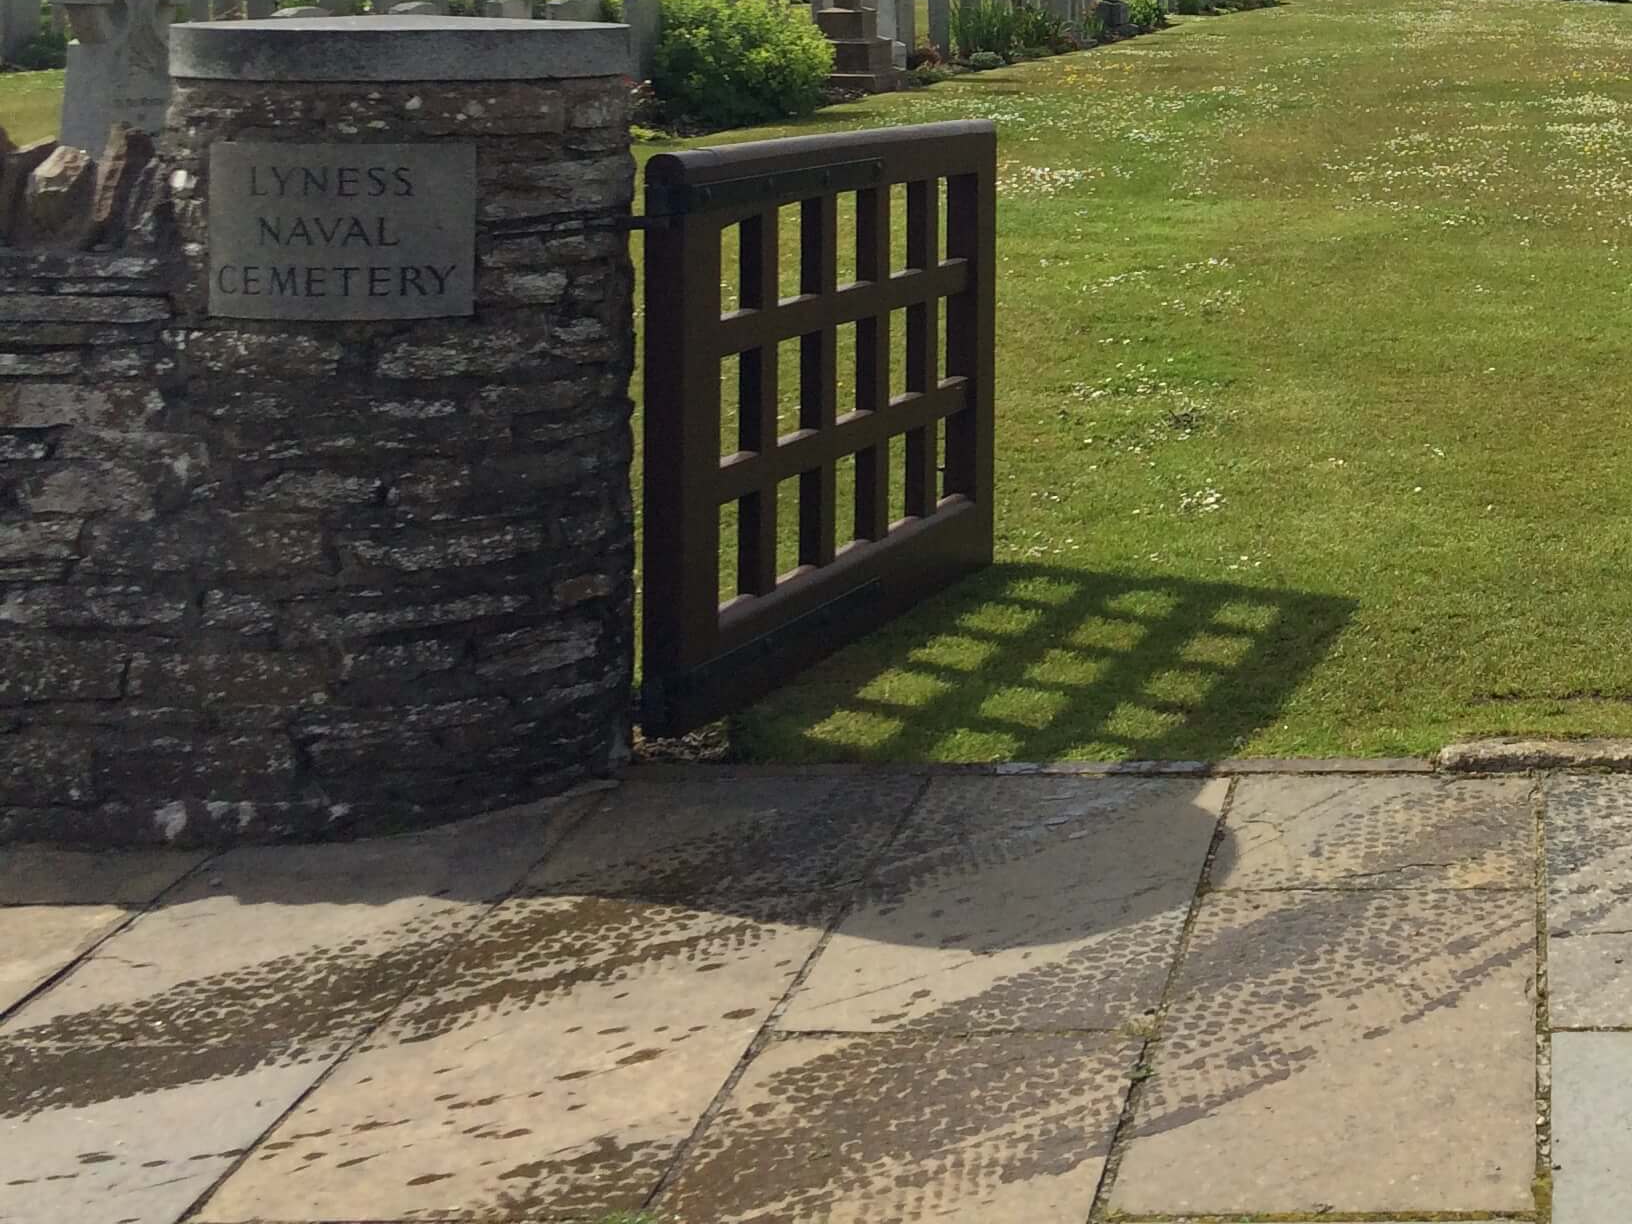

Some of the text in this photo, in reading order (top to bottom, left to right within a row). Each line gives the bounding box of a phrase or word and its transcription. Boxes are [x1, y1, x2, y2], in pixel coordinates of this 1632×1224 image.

[250, 166, 415, 197] LYNESS
[258, 216, 400, 247] NAVAL
[218, 264, 456, 297] CEMETERY
